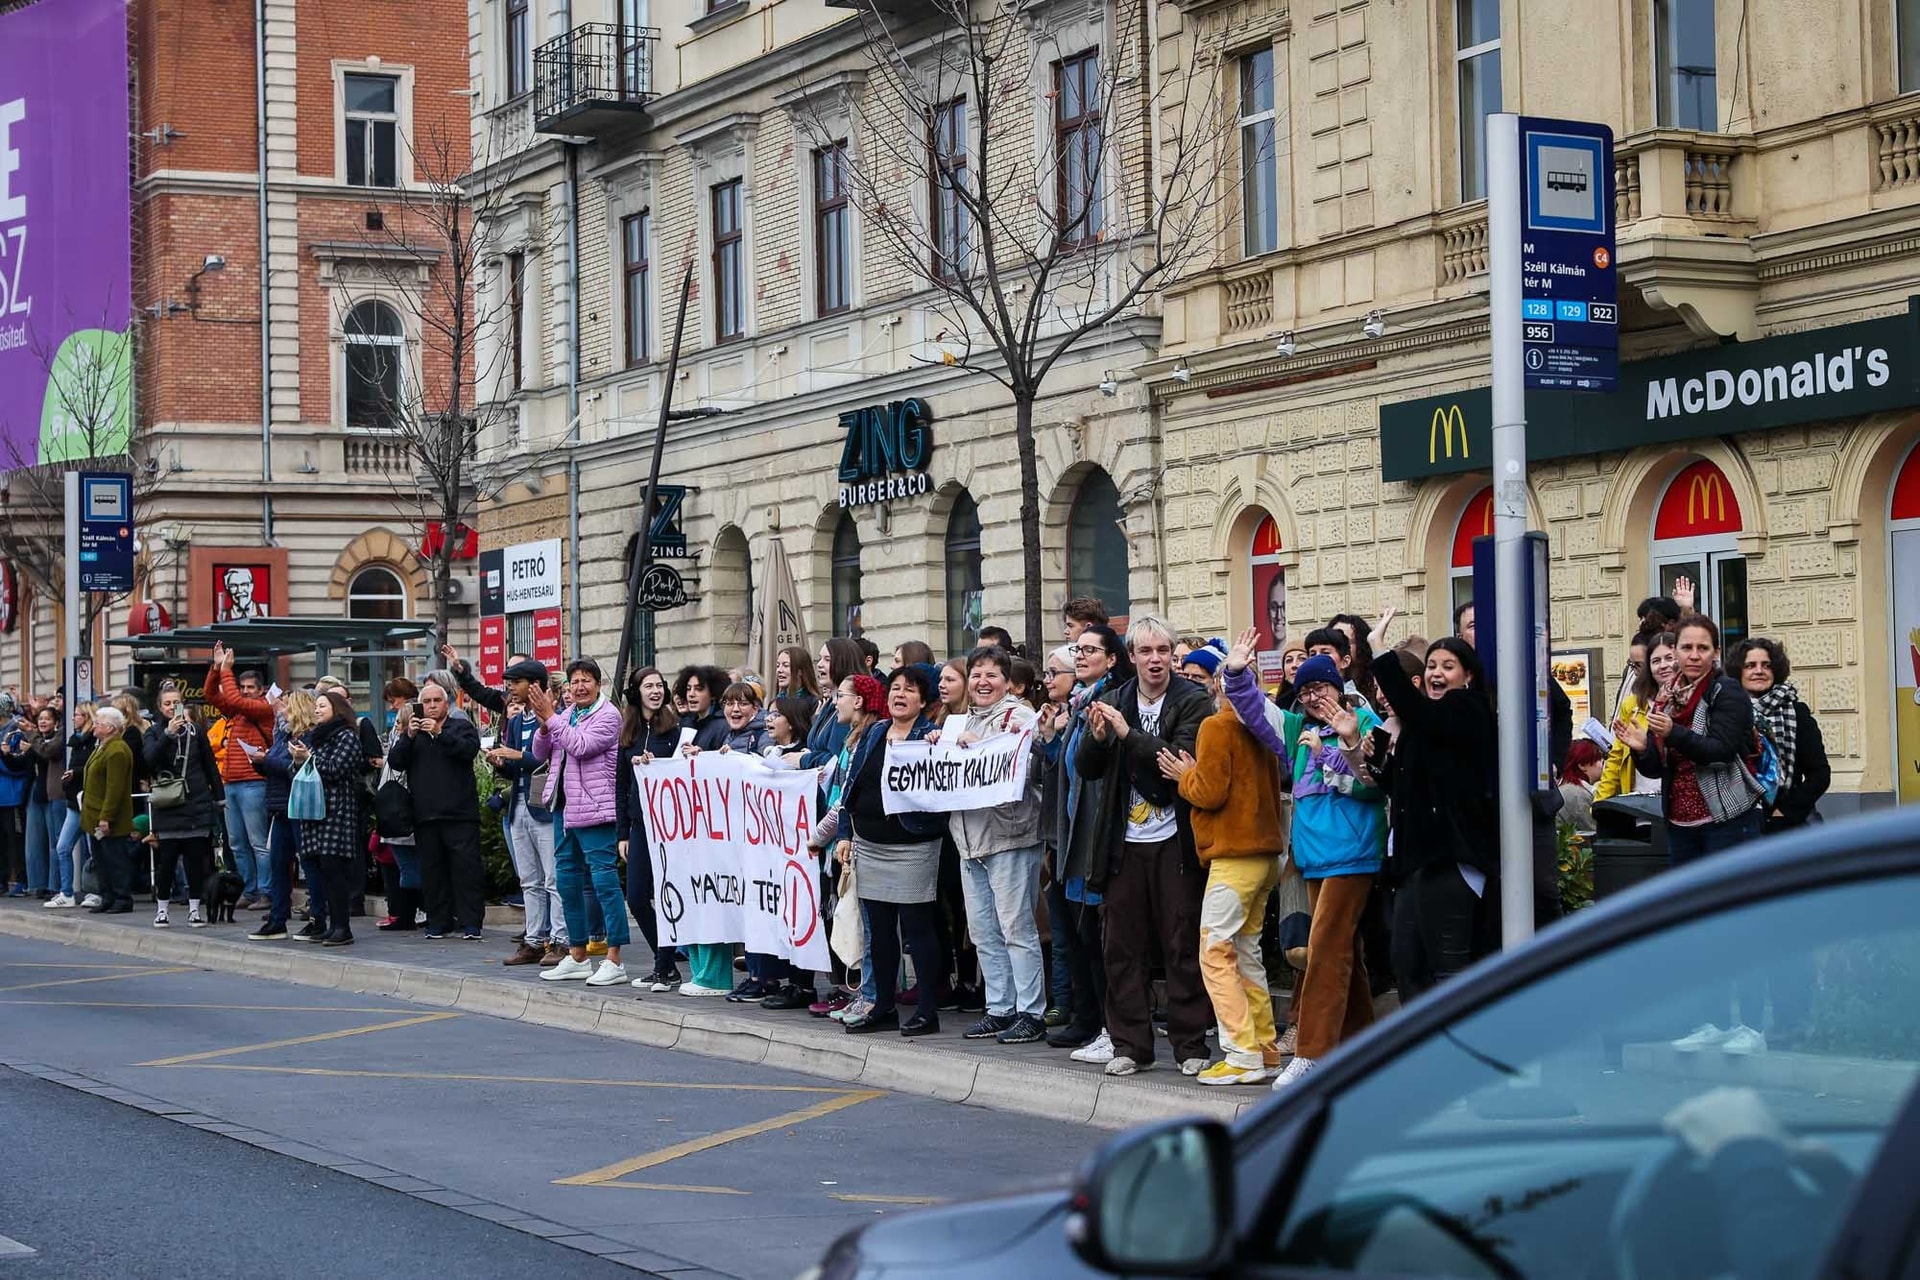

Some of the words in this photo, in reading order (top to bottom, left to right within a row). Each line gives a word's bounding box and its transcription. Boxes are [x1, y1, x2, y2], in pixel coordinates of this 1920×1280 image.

[1523, 243, 1535, 254] M
[1595, 252, 1608, 264] C4
[1524, 261, 1547, 273] Széll
[1550, 263, 1586, 277] Kálmán
[1524, 277, 1539, 288] tér
[1541, 278, 1552, 289] M
[1527, 303, 1548, 315] 128
[1562, 305, 1581, 317] 129
[1593, 307, 1613, 319] 922
[1526, 326, 1549, 339] 956
[1646, 346, 1890, 420] McDonald's
[838, 397, 928, 483] ZING
[840, 472, 926, 508] BURGER&CO
[651, 546, 685, 558] ZING
[512, 551, 546, 581] PETRÓ
[888, 747, 962, 792] EGYMÁSÉRT
[644, 759, 731, 844] KODÁLY
[741, 779, 814, 861] ISKOLA
